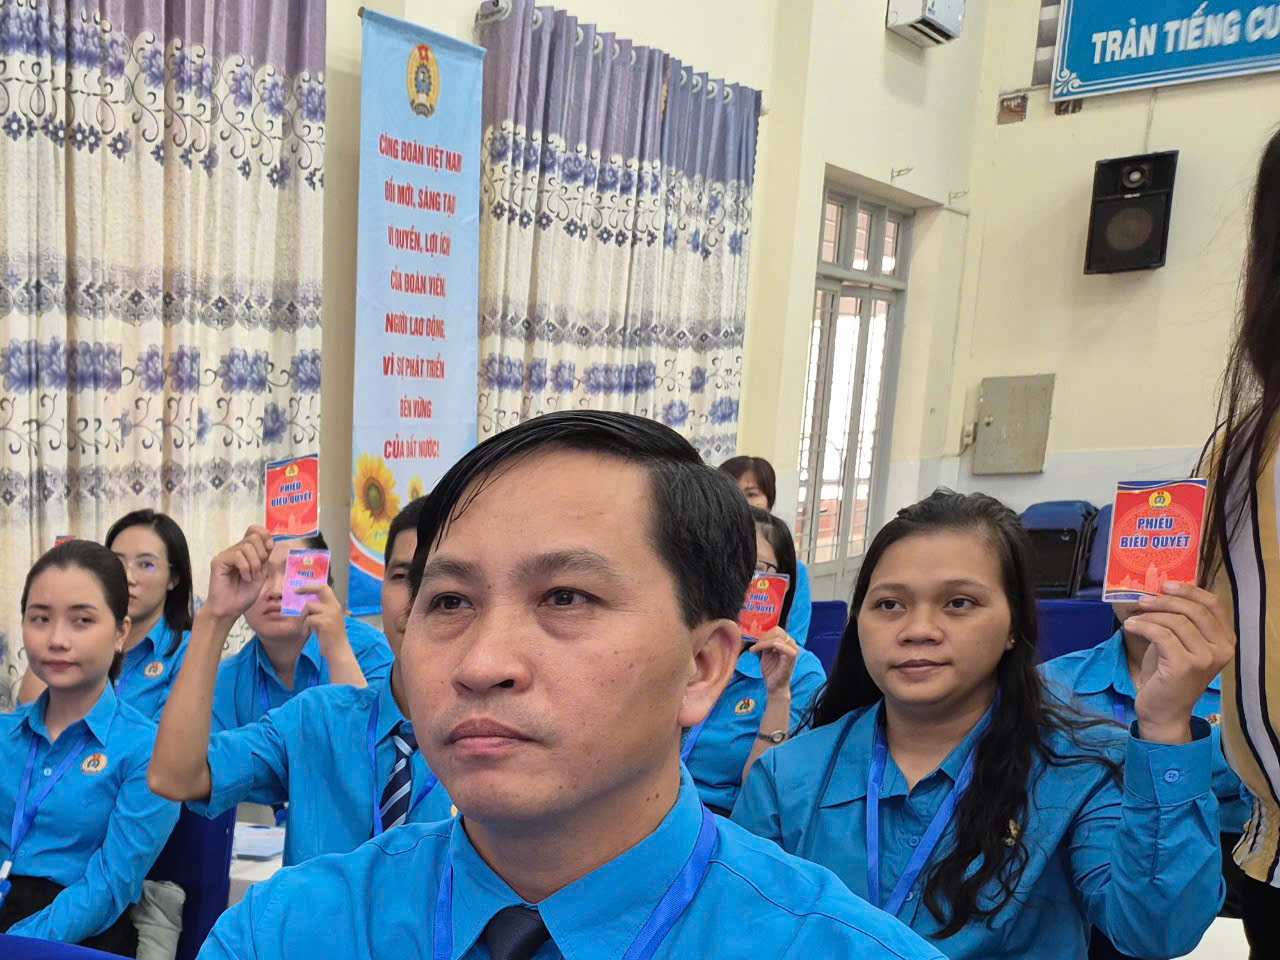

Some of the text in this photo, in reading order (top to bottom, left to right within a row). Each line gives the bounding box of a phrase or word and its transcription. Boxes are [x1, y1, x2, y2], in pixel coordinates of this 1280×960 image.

[1163, 1, 1241, 53] TIẾNG
[379, 132, 463, 174] CÔNG ĐOÀN VIỆT NAM
[418, 186, 441, 212] SÁNG
[390, 265, 402, 292] CỦA
[404, 270, 426, 294] ĐOÀN
[385, 312, 407, 336] NGƯỜI
[409, 316, 424, 336] LAO
[405, 354, 424, 378] PHÁT
[426, 352, 445, 379] TRIỂN
[413, 395, 431, 419] VỮNG
[384, 433, 404, 460] CỦA
[1137, 514, 1174, 530] PHIẾU
[1120, 532, 1191, 549] BIỂU QUYẾT
